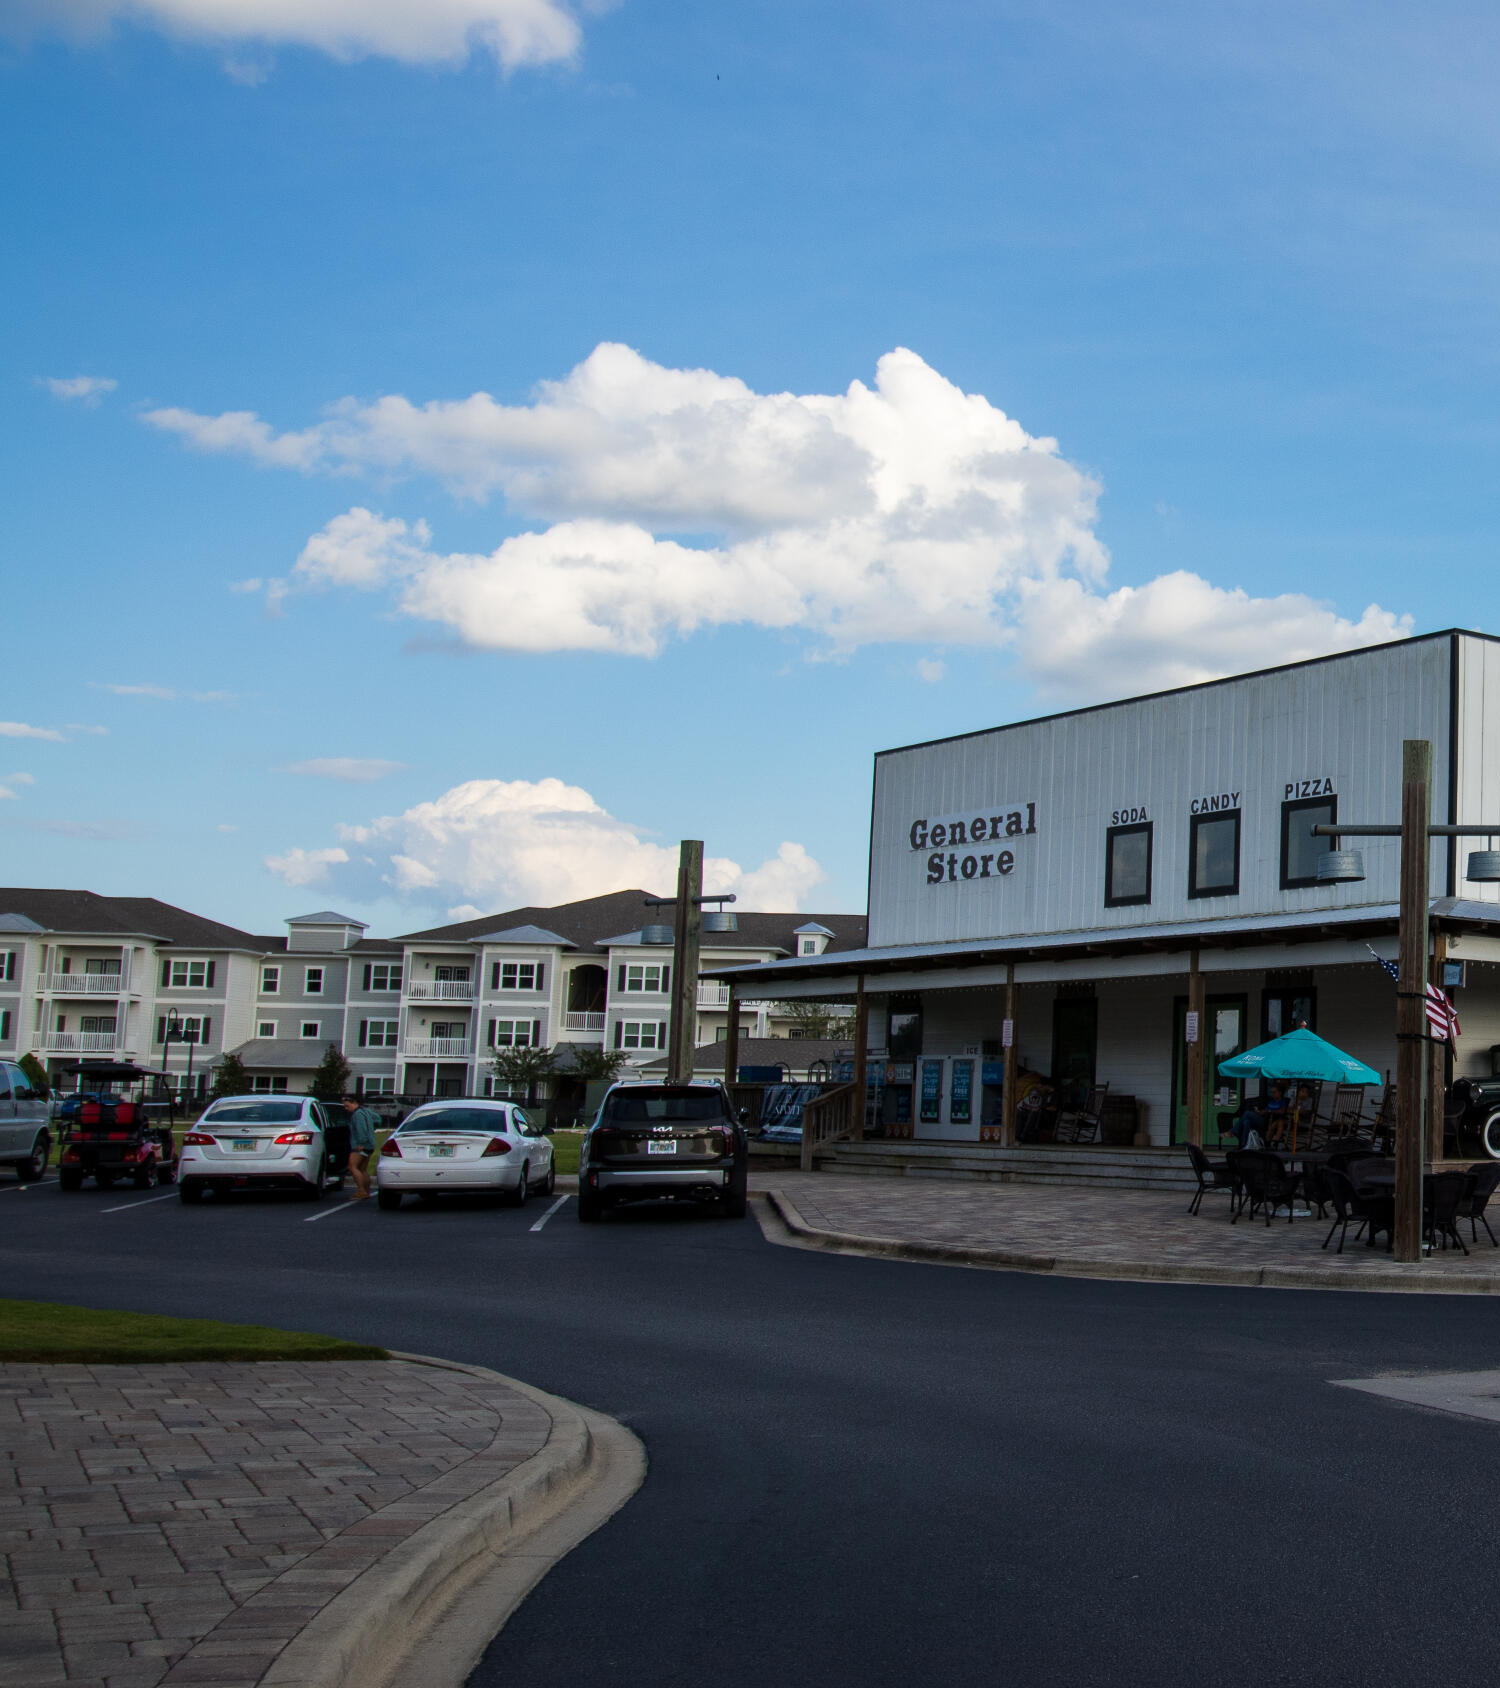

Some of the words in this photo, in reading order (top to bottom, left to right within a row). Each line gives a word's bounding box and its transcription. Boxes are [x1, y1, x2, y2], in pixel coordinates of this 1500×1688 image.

[1284, 777, 1334, 800] PIZZA
[1190, 792, 1241, 814] CANDY
[909, 802, 1037, 850] General
[1111, 806, 1148, 825] SODA
[926, 850, 1015, 885] Store
[966, 1047, 978, 1055] ICE
